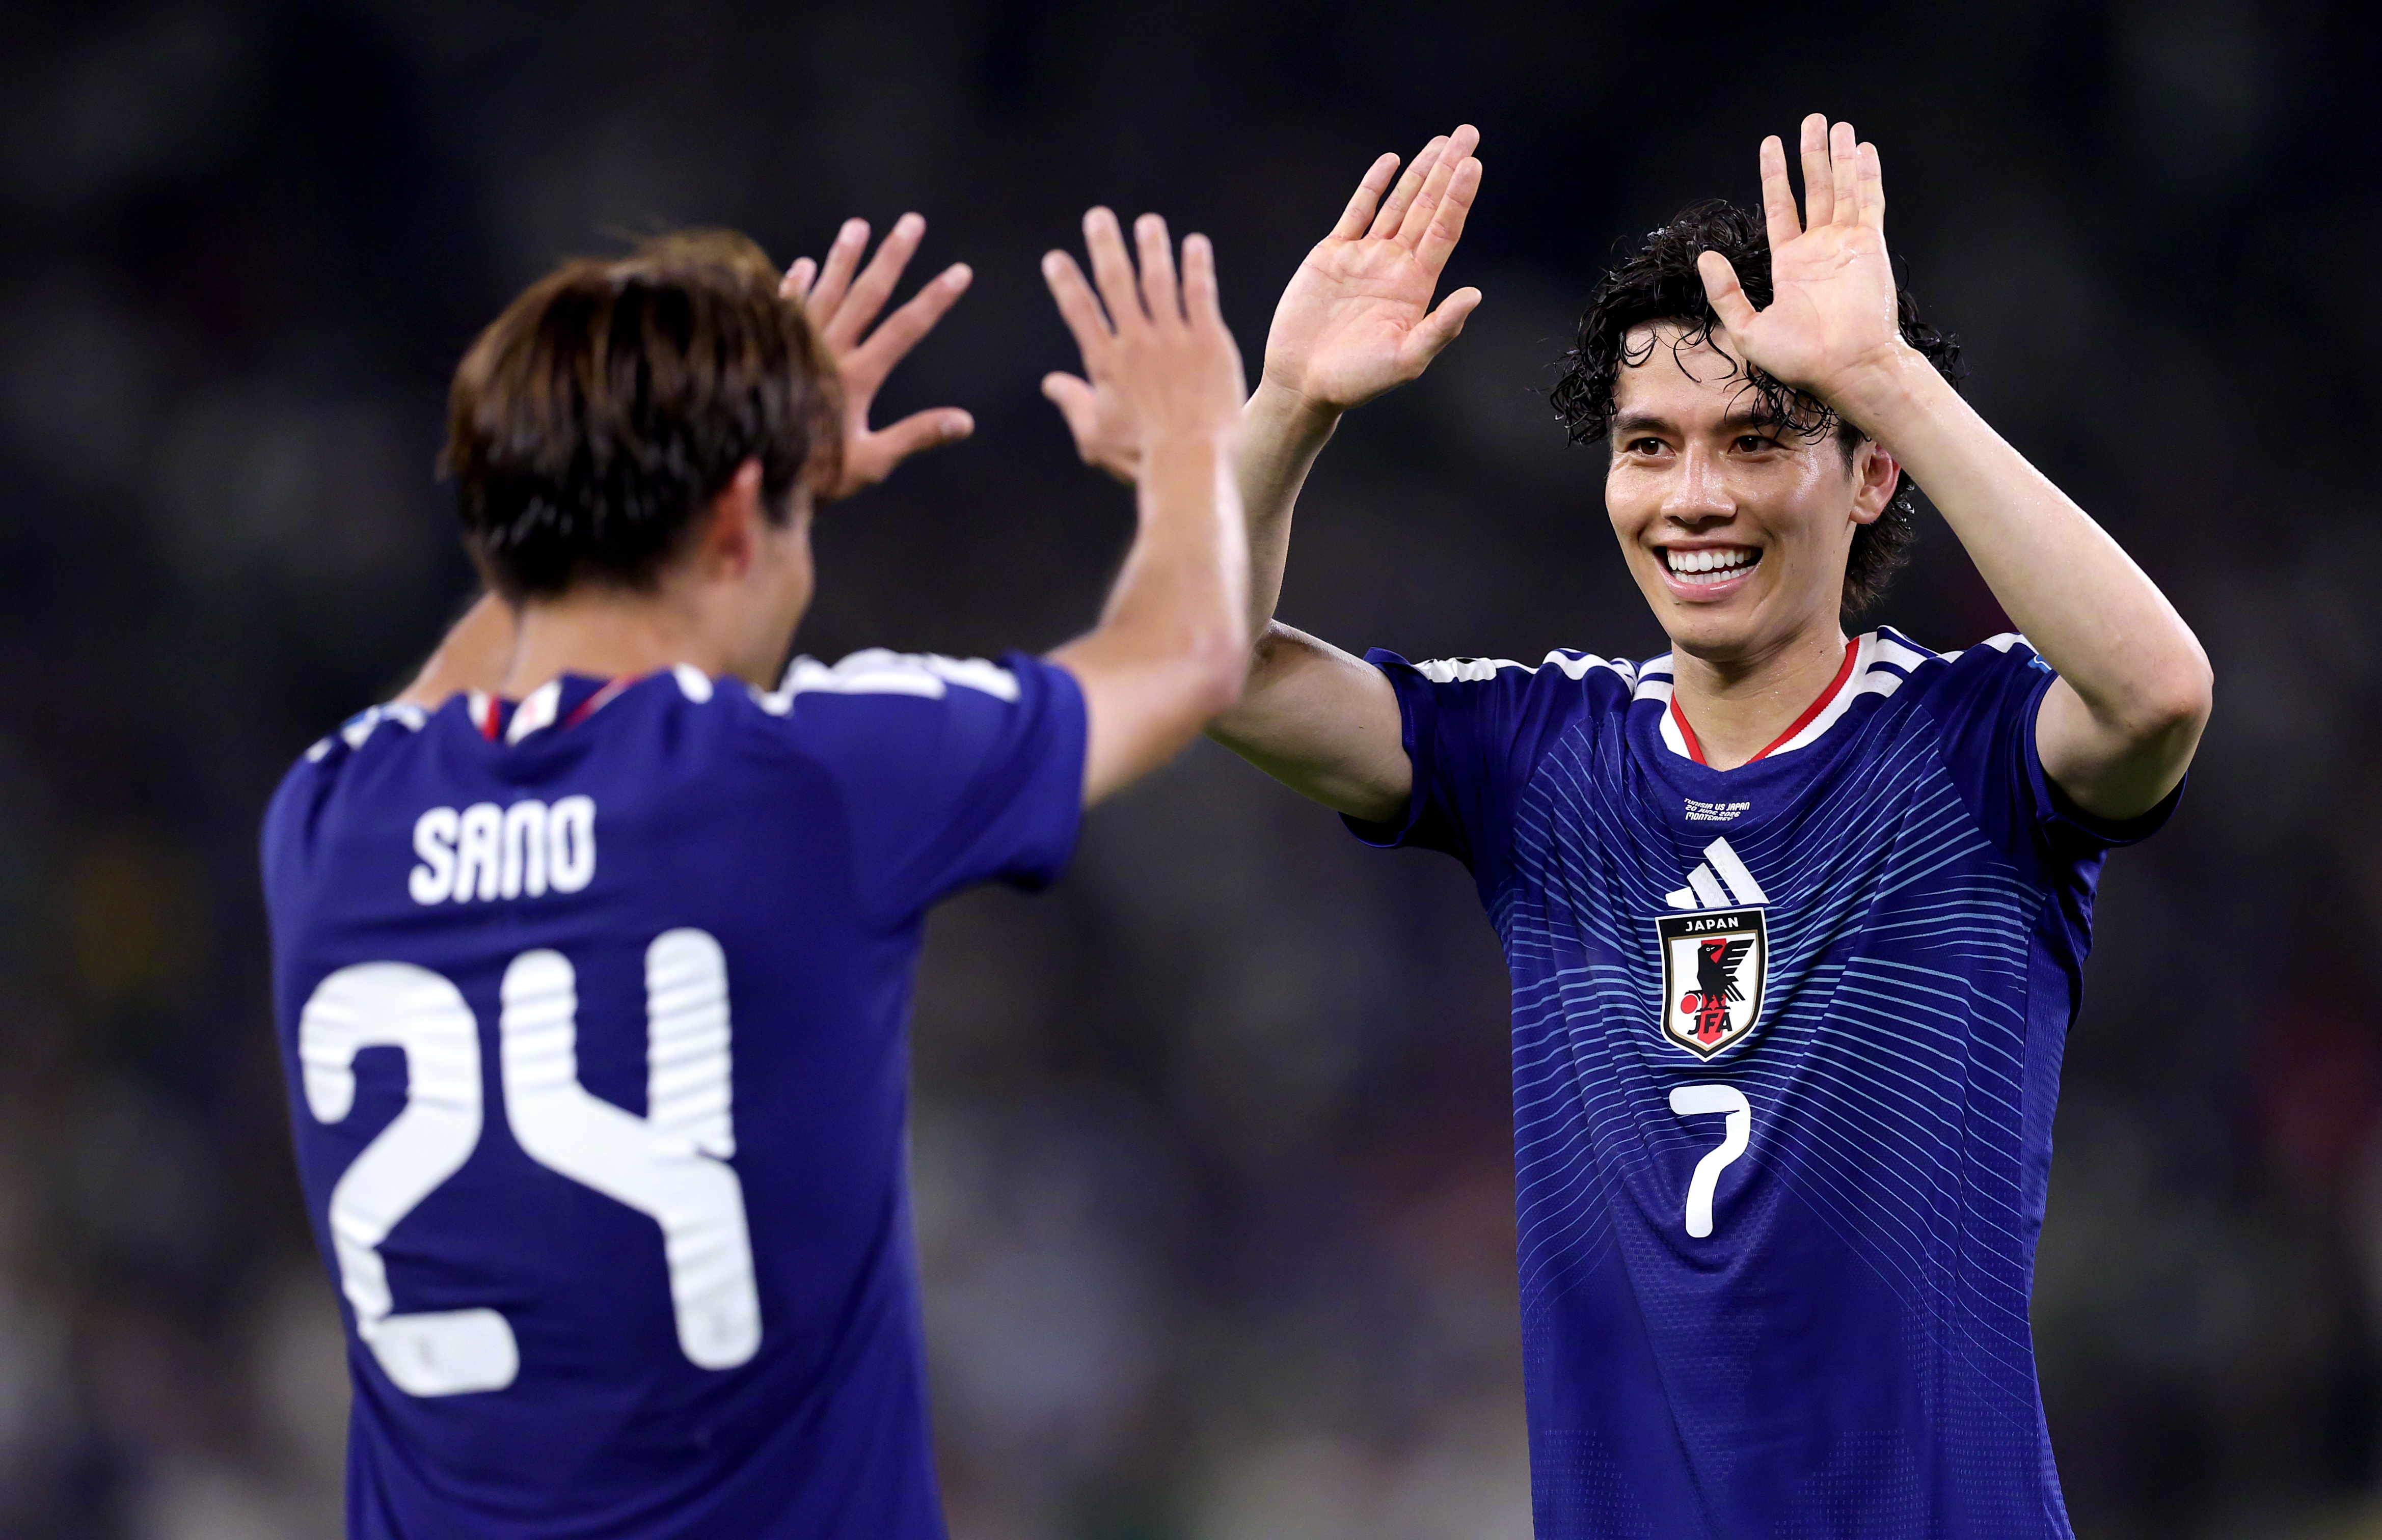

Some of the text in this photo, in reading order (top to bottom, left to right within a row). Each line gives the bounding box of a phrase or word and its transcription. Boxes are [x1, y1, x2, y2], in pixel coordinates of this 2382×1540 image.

[1684, 798, 1714, 810] TUNISIA
[1726, 802, 1750, 811] JAPAN
[1685, 811, 1734, 821] MONTERREY
[409, 794, 596, 905] SANO
[1685, 917, 1739, 932] JAPAN
[1687, 1012, 1733, 1035] JFA
[299, 928, 762, 1397] 24
[1669, 1084, 1751, 1238] 7
